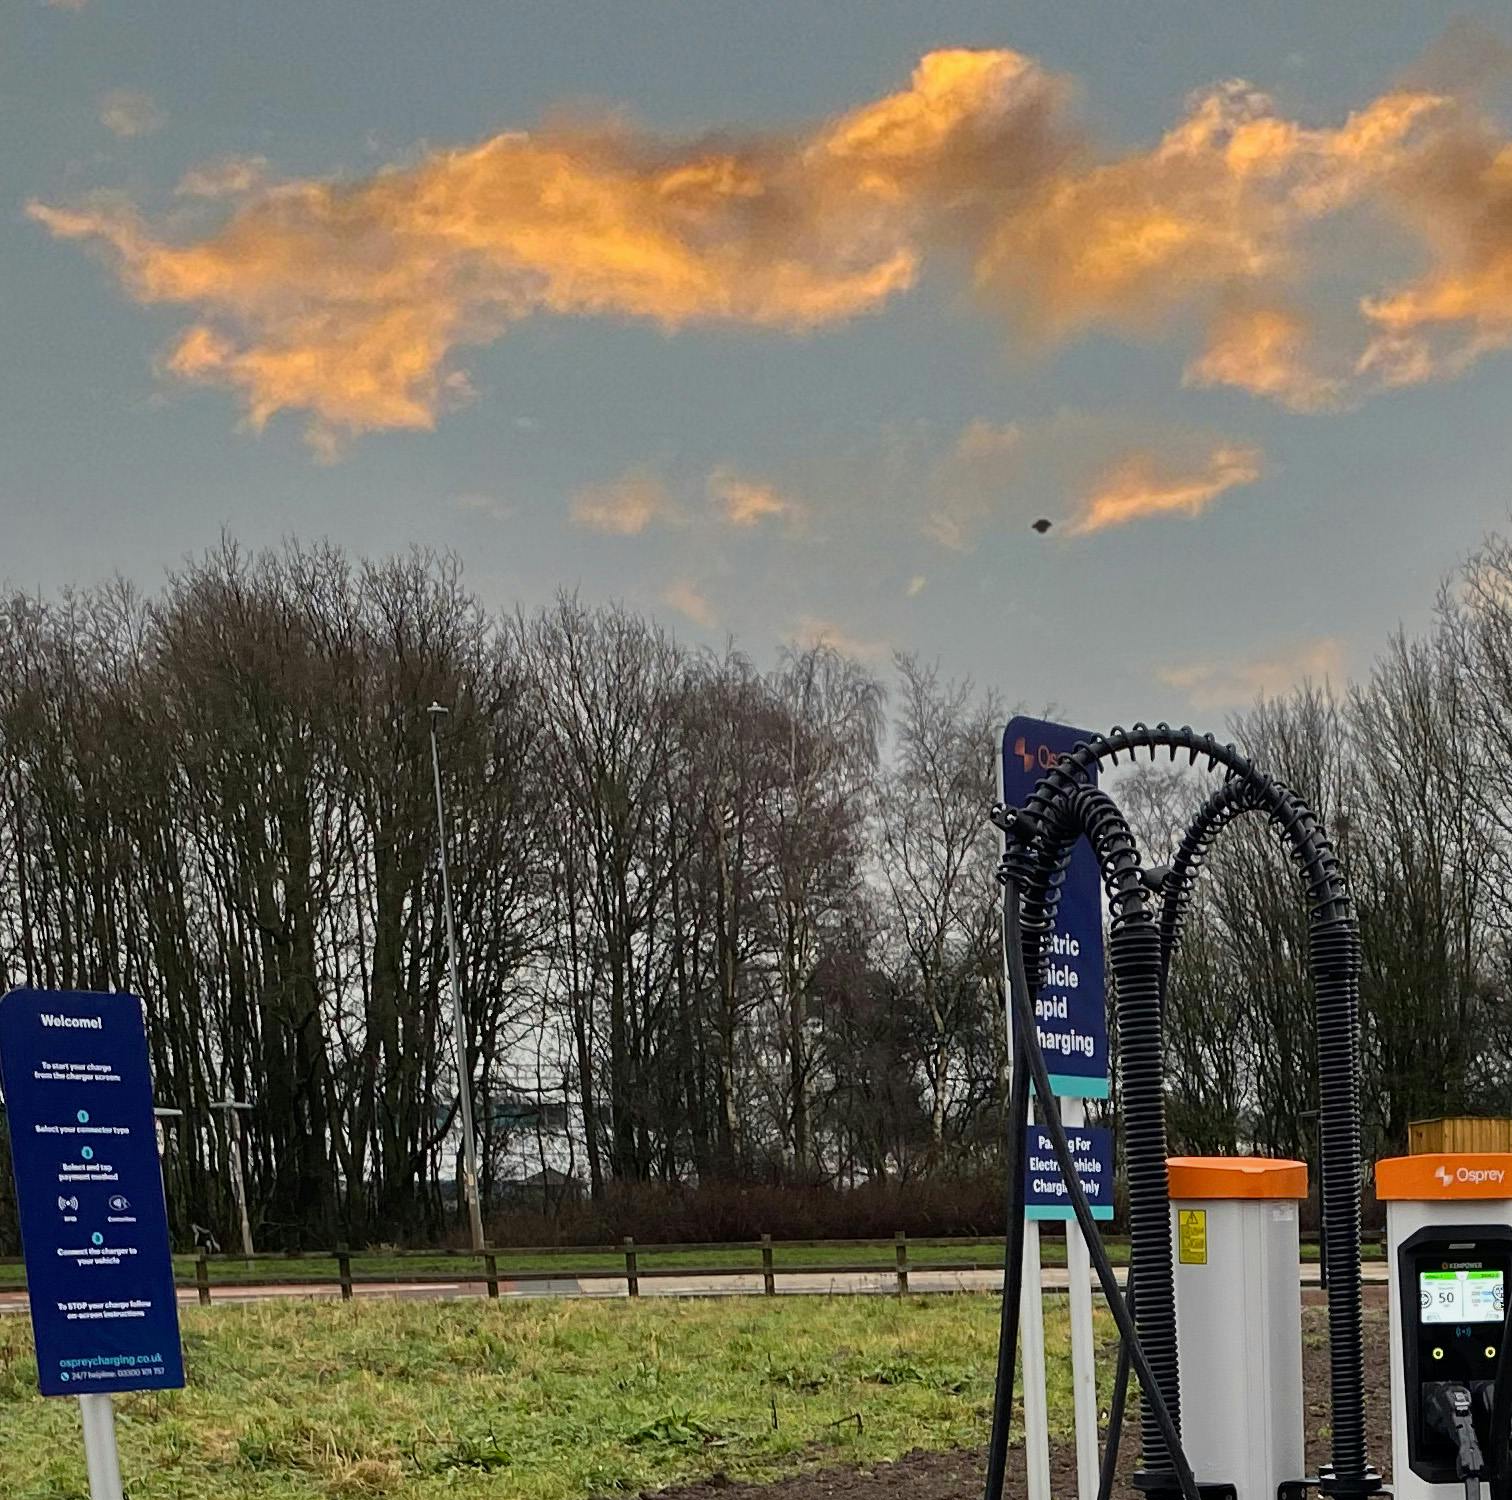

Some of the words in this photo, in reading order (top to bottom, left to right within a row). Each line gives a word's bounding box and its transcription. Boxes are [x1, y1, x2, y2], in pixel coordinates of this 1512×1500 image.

[1039, 932, 1080, 957] tric
[1046, 963, 1079, 988] icle
[1035, 995, 1068, 1021] apid
[40, 1013, 103, 1030] Welcome!
[1036, 1025, 1094, 1058] harging
[1075, 1137, 1092, 1151] For
[1029, 1157, 1061, 1172] Electri
[1073, 1158, 1102, 1173] ehicle
[1456, 1167, 1505, 1185] Osprey
[1033, 1179, 1069, 1197] Chargi
[1438, 1291, 1455, 1304] 50
[59, 1352, 163, 1369] ospreycharging.co.uk
